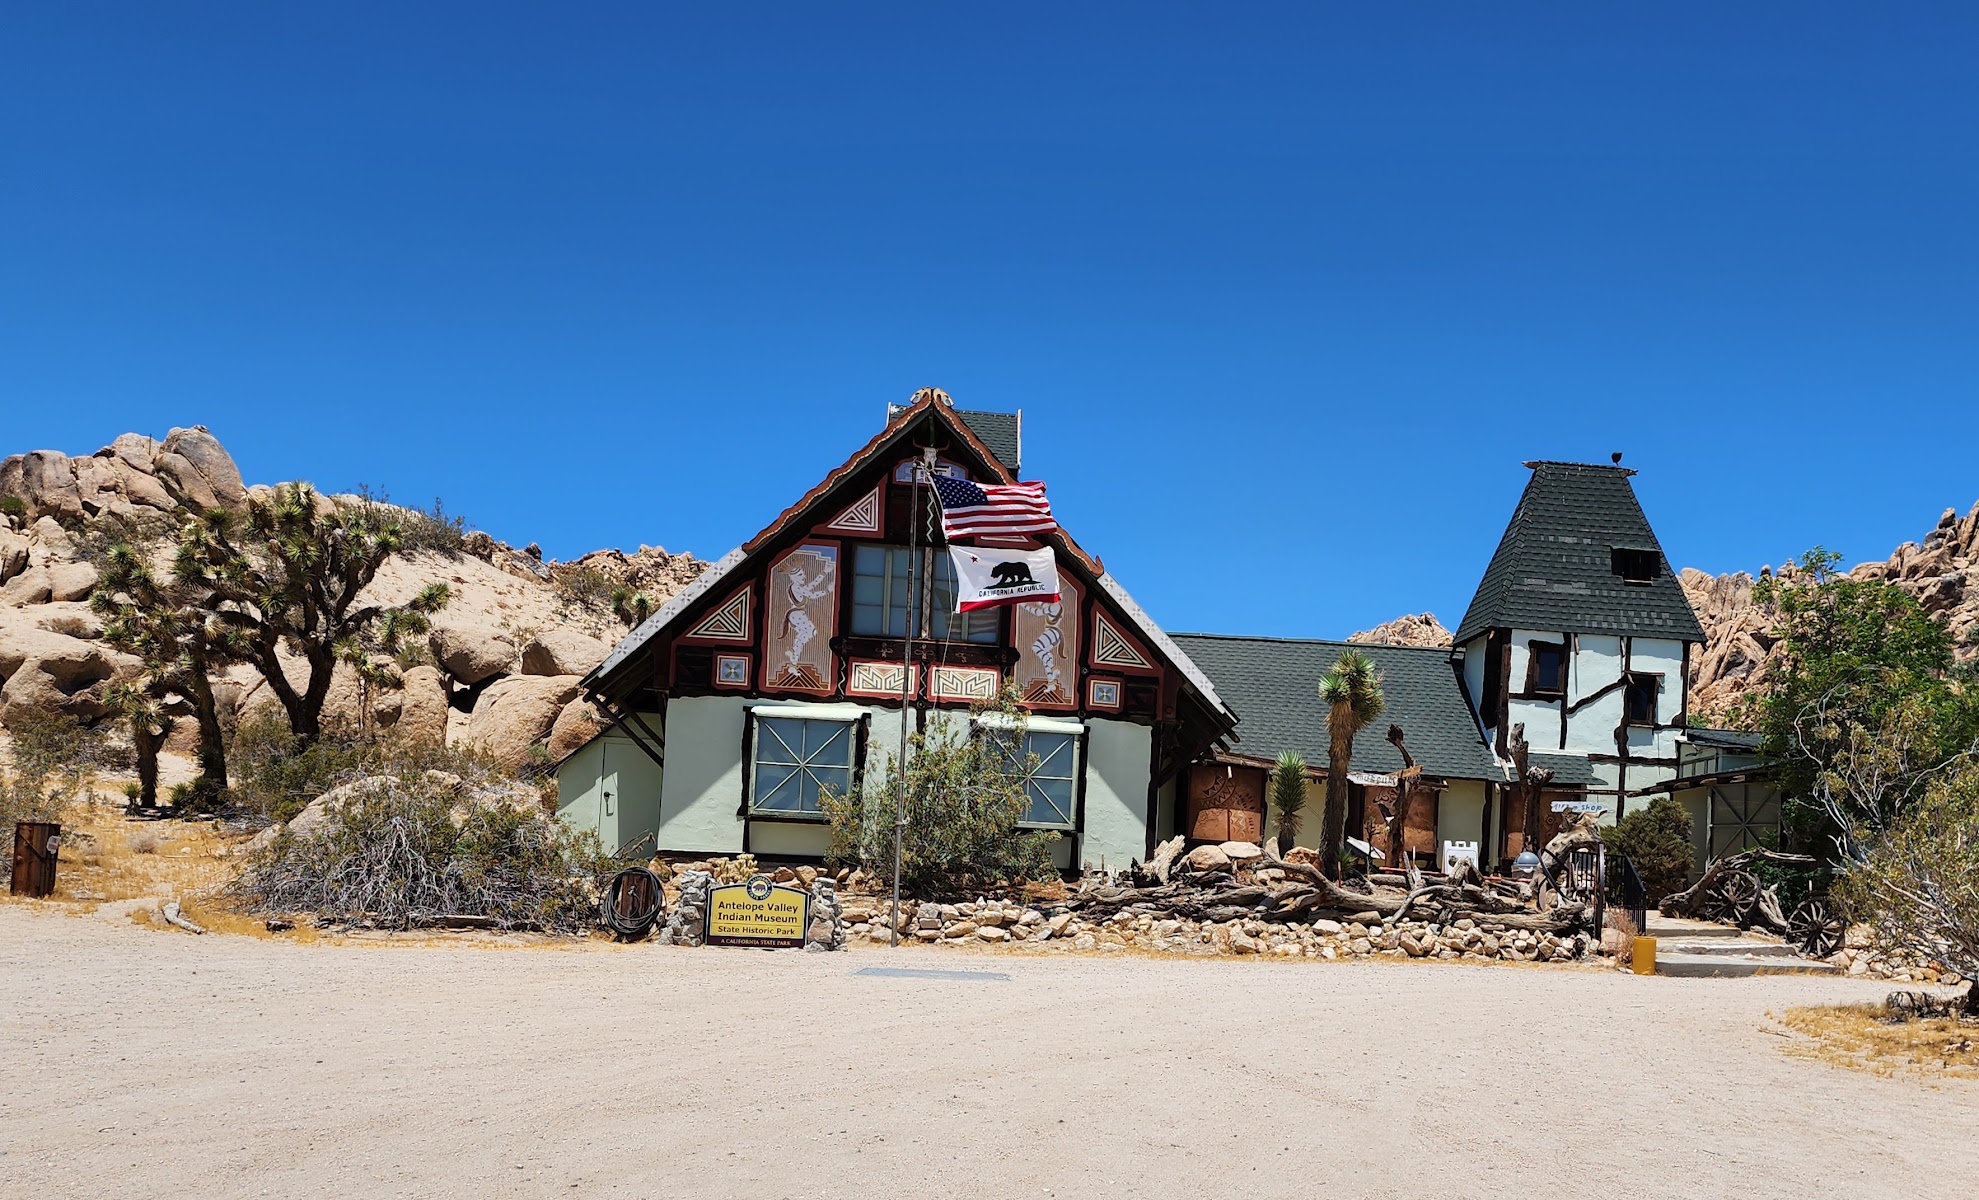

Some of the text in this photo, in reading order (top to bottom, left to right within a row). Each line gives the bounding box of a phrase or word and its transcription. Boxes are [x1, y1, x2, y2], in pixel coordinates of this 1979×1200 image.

[978, 584, 1046, 598] CALIFORNIA REPUBLIC
[718, 901, 799, 914] Antelope Valley
[718, 912, 798, 923] Indian Museum
[718, 925, 740, 933] State
[742, 926, 774, 934] Historic
